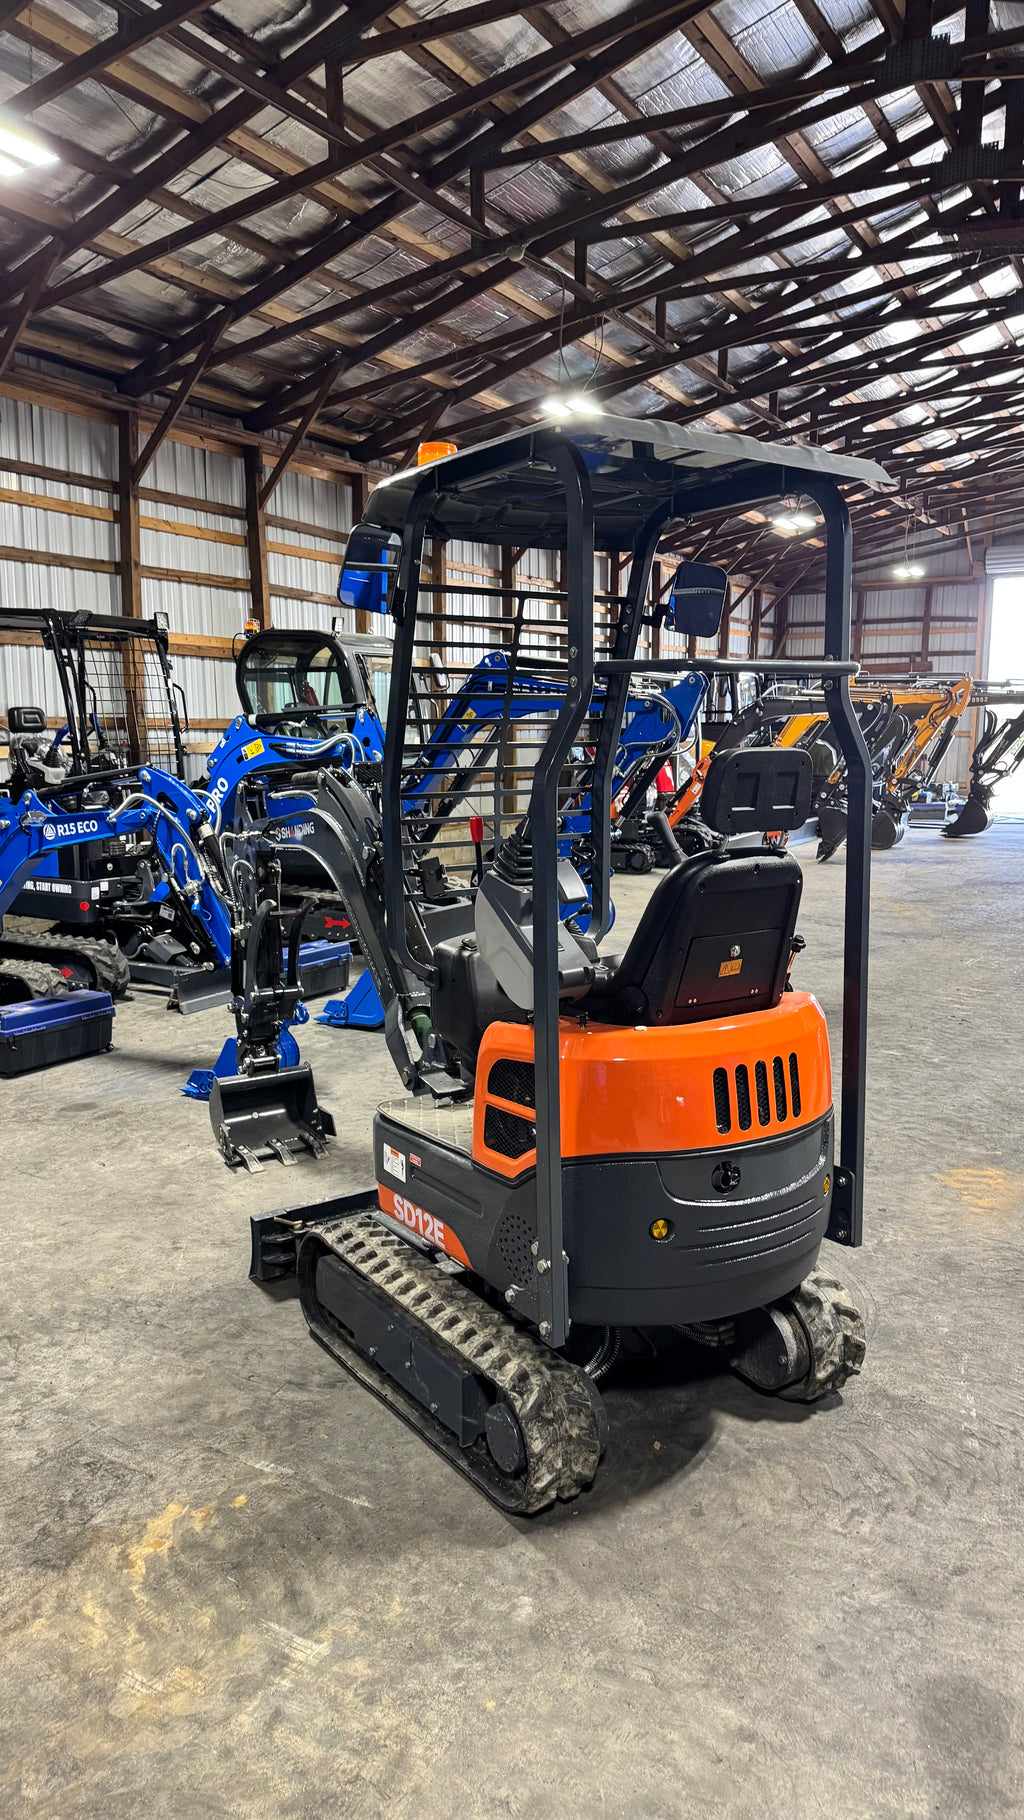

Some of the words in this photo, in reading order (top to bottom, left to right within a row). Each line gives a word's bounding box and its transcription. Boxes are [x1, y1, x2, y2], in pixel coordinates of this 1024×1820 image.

[206, 777, 229, 814] PRO
[57, 822, 77, 837] R15
[77, 819, 98, 834] ECO
[36, 881, 51, 892] START
[51, 883, 72, 894] OWNING
[393, 1193, 446, 1250] SD12E
